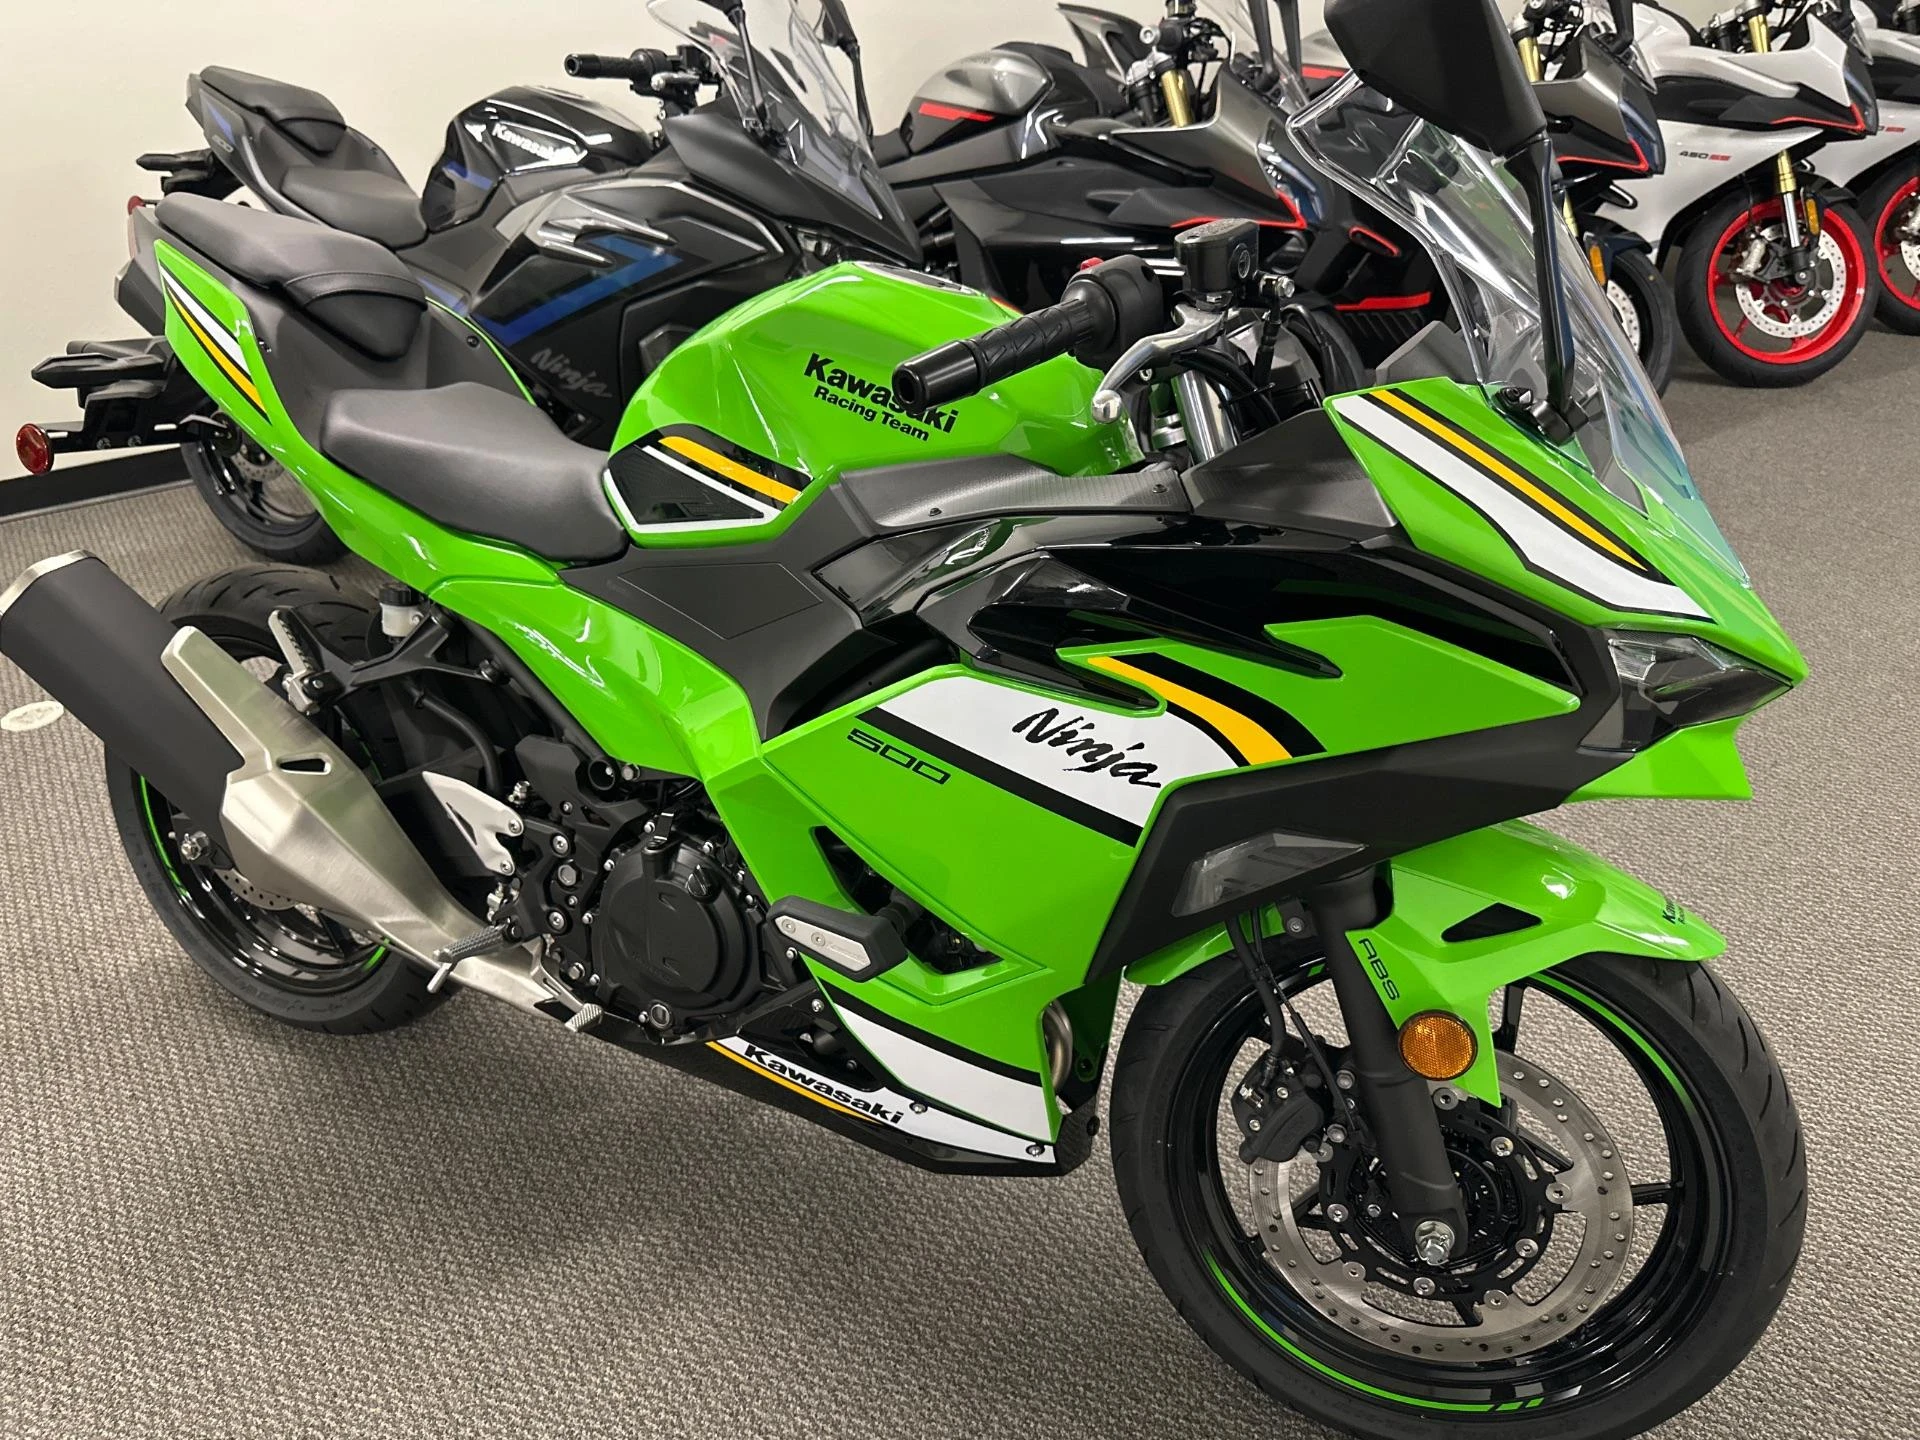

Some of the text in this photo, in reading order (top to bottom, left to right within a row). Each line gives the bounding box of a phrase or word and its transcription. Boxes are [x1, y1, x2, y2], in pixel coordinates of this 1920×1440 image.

[530, 347, 613, 398] Ninja
[814, 385, 930, 441] Racing Team
[847, 727, 951, 785] 500
[1011, 707, 1162, 788] Ninja
[1358, 937, 1400, 1001] ABS
[744, 1043, 904, 1125] Kawasaki
